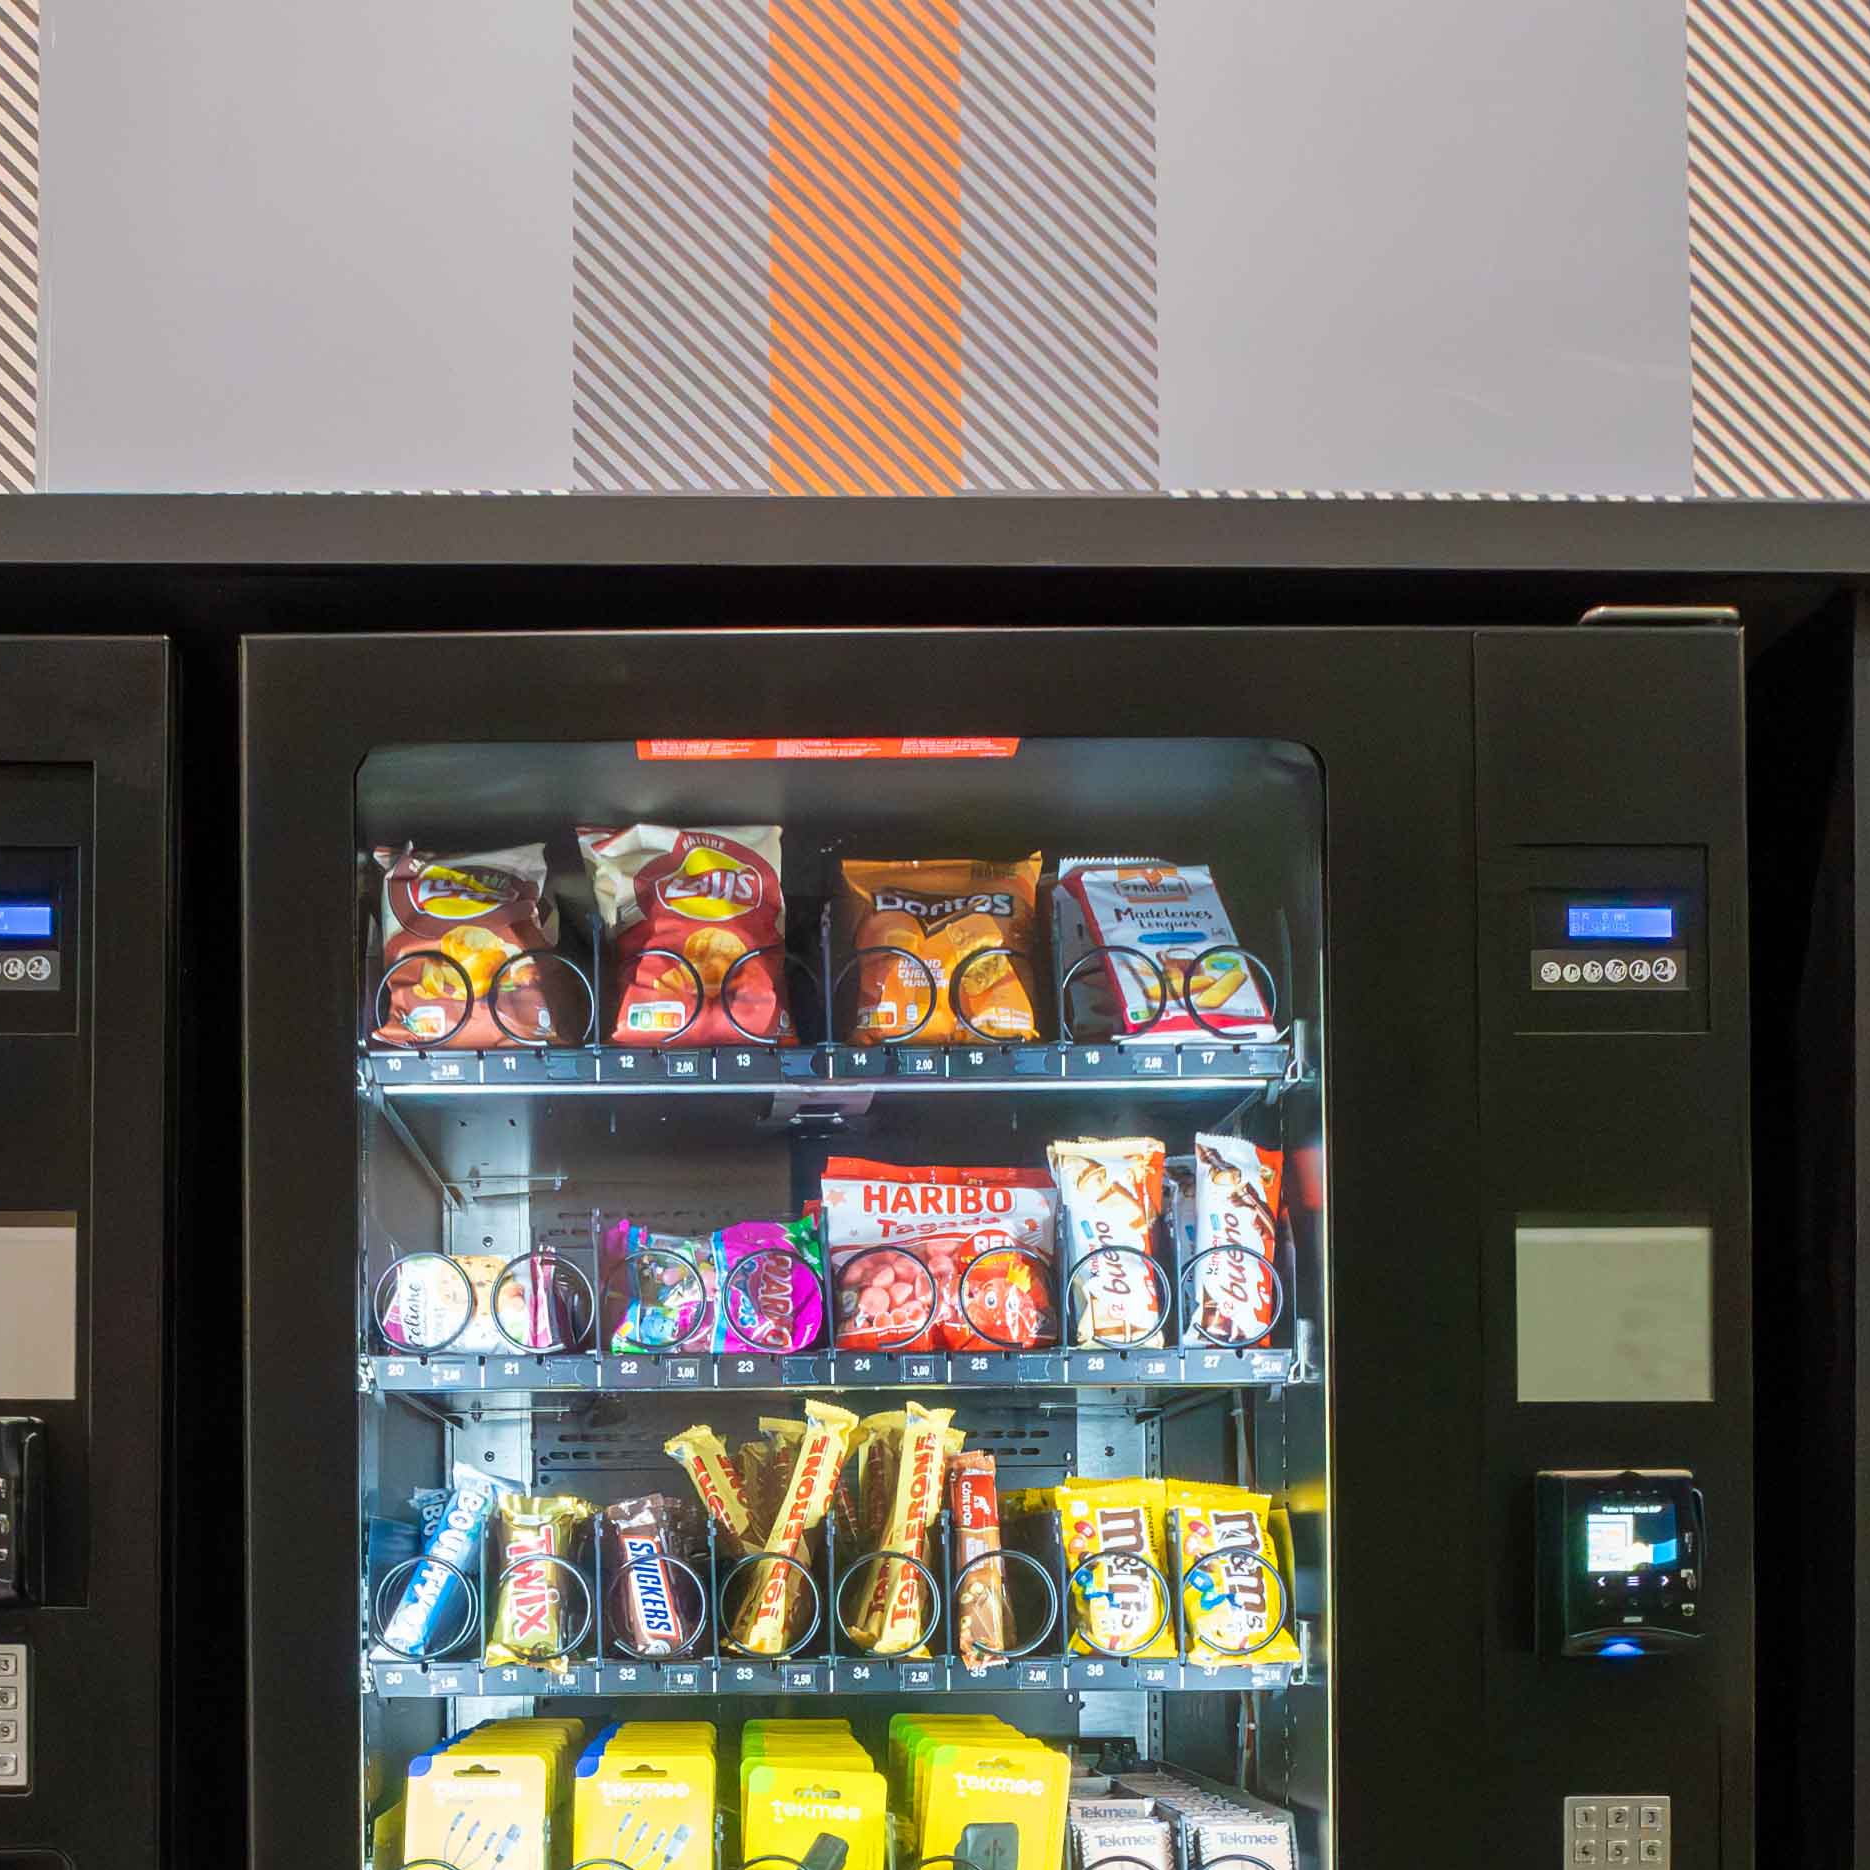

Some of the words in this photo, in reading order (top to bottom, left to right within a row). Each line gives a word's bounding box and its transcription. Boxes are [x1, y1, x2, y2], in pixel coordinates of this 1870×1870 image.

[875, 894, 1013, 917] Doritos
[862, 1184, 1014, 1215] HARIBO
[1221, 1212, 1250, 1304] bueno
[507, 1525, 555, 1640] TWIX
[628, 1540, 673, 1635] SNICKERS
[771, 1800, 861, 1823] tekmee
[1079, 1805, 1139, 1820] Tekmee
[1094, 1834, 1156, 1849] Tekmee
[1216, 1832, 1279, 1847] Tekmee
